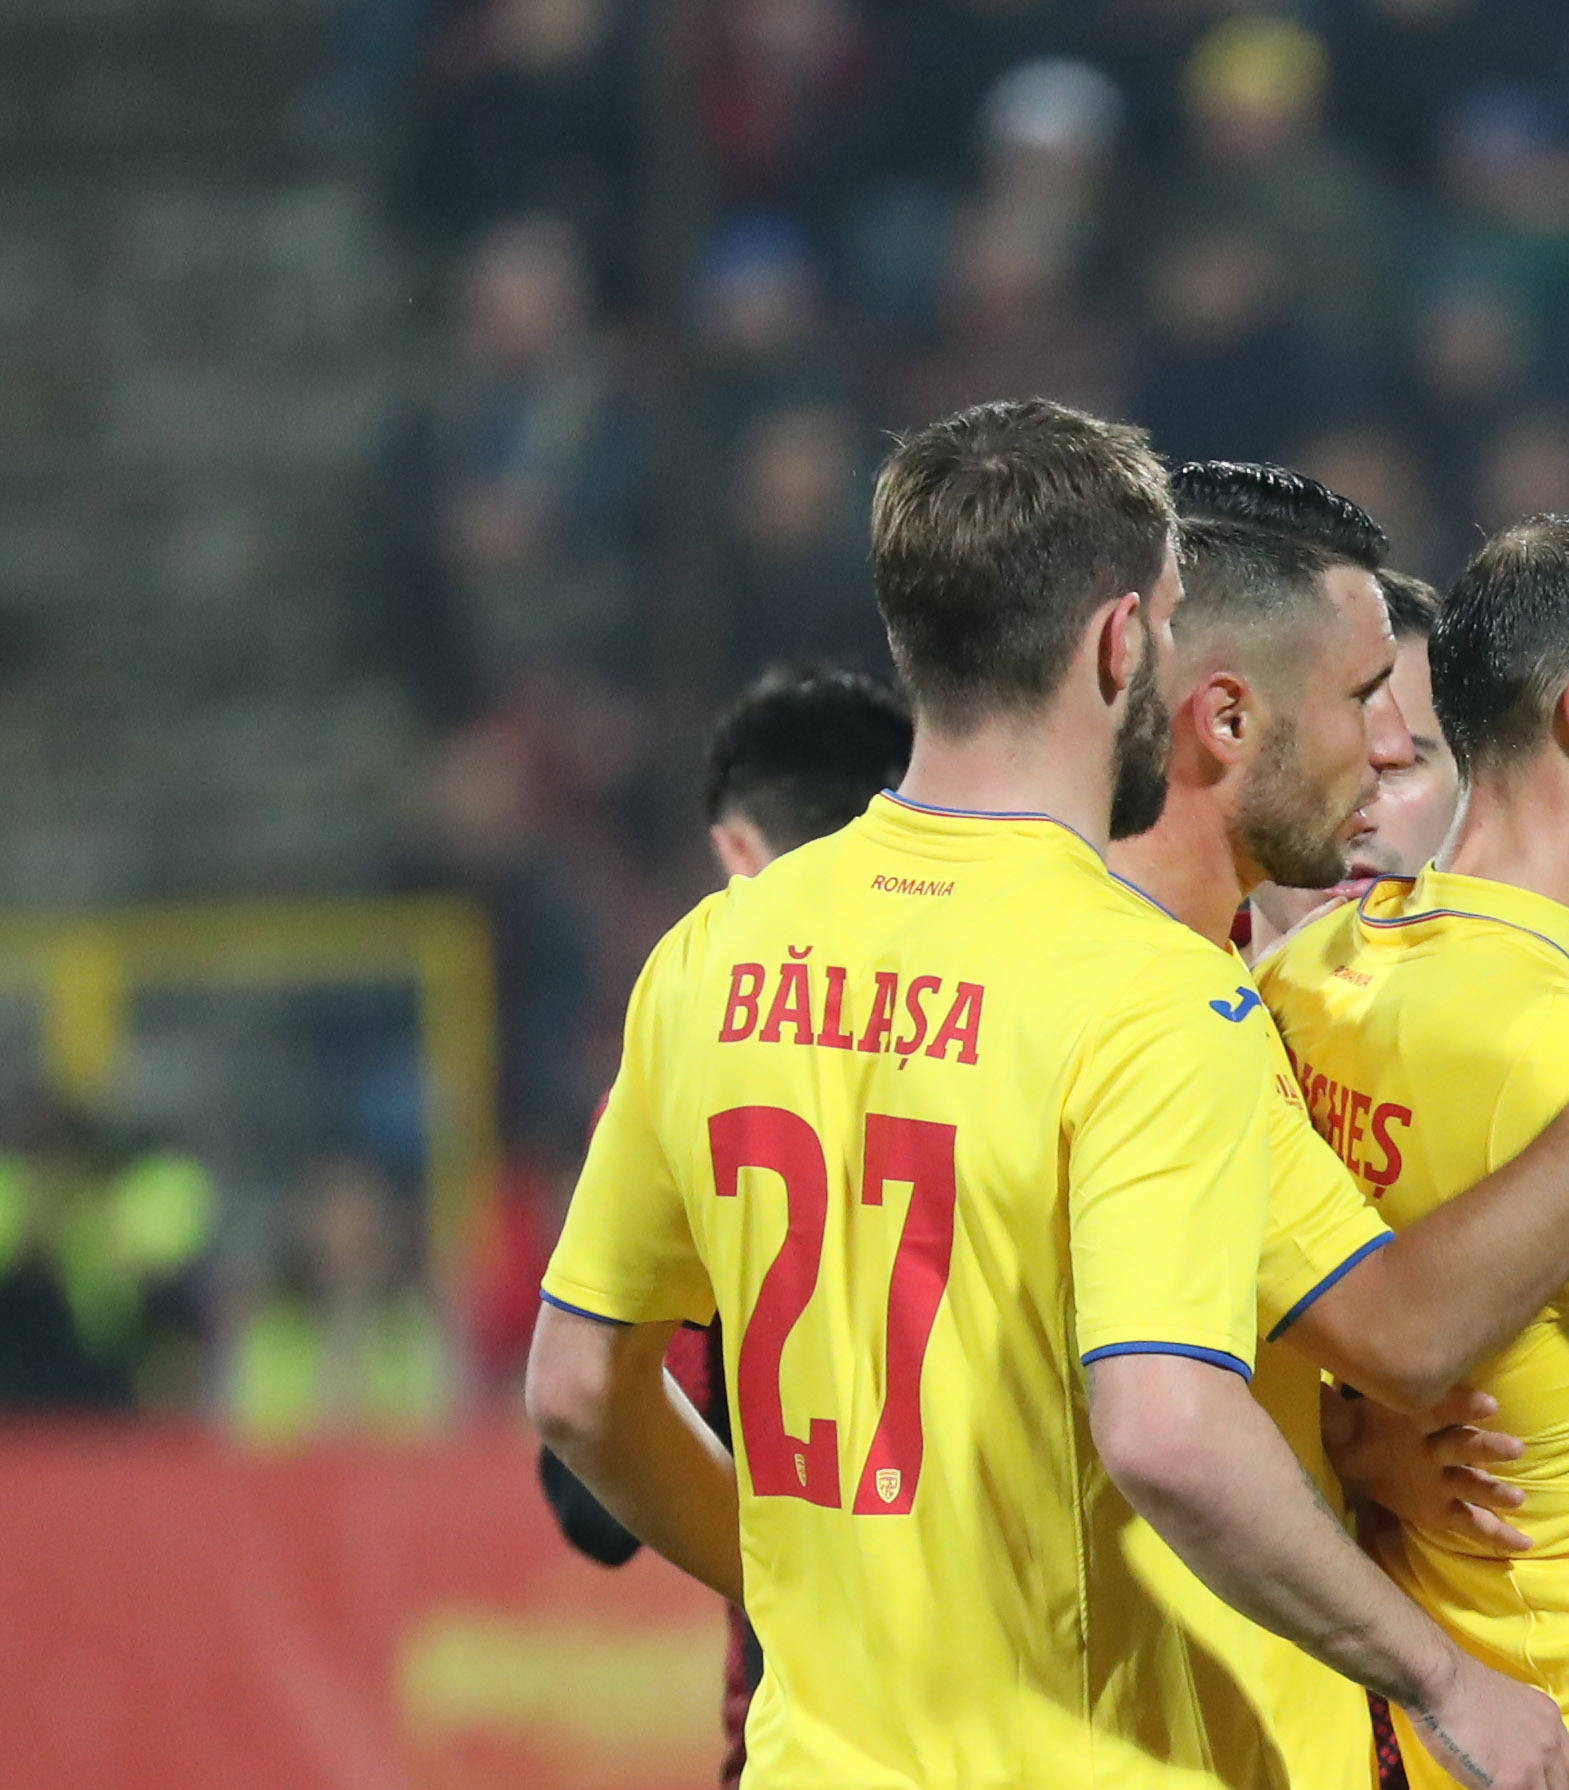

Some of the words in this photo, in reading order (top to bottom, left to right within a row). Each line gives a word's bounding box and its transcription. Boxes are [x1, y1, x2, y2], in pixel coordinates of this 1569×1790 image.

[870, 874, 956, 897] ROMANIA
[718, 945, 986, 1071] BĂLAȘA
[707, 1105, 958, 1515] 27
